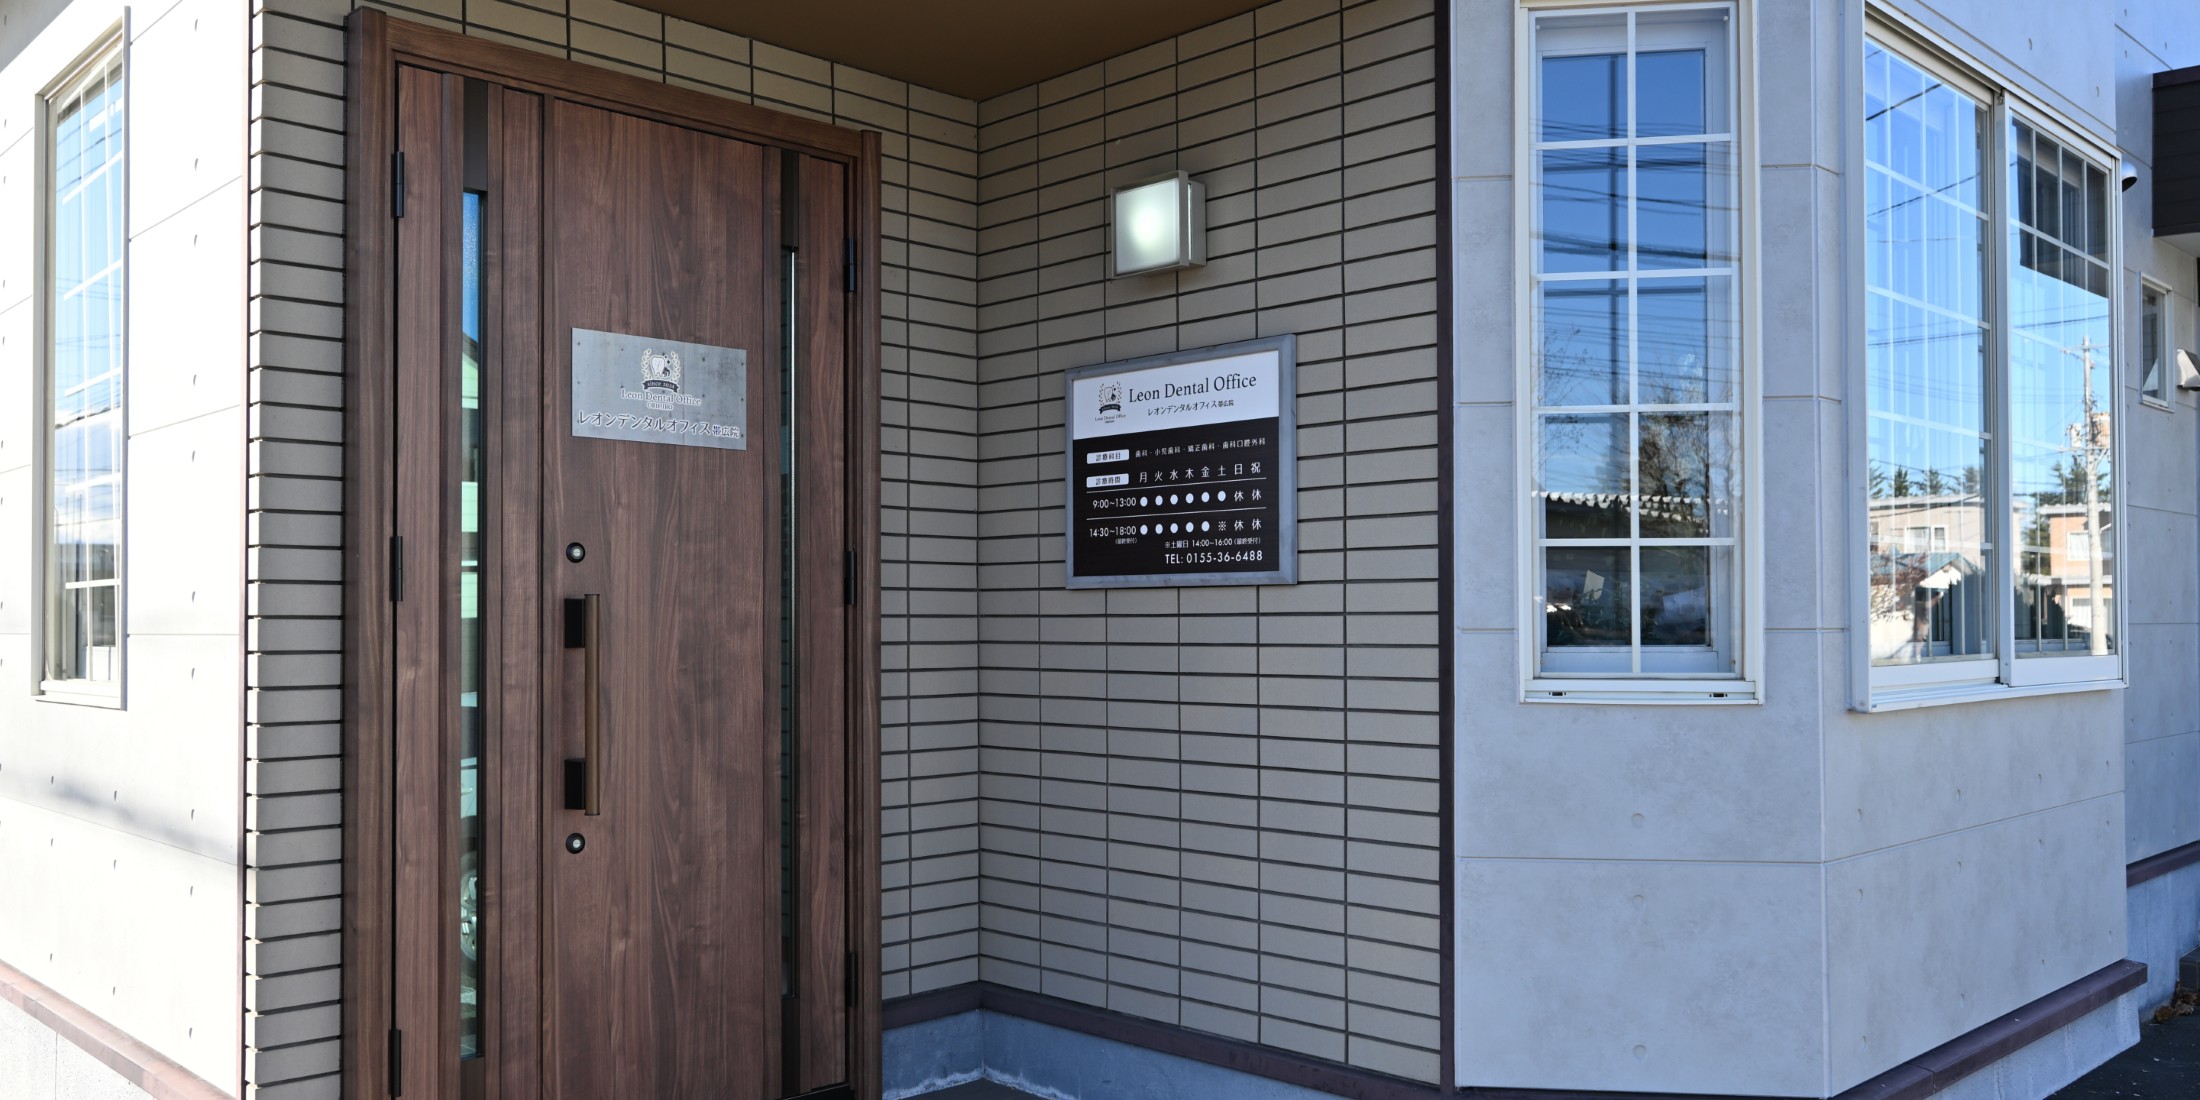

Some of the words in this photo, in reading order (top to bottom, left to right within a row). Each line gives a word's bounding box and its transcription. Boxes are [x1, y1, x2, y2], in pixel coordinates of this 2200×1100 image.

[1130, 388, 1160, 403] Leon
[1165, 378, 1209, 398] Dental
[1214, 373, 1256, 391] Office
[621, 390, 643, 400] Leon
[646, 392, 674, 403] Dental
[676, 396, 702, 406] Office
[1148, 399, 1234, 416] レオンデンタルオフィス帯広院
[578, 410, 740, 439] レオンデンタルオフィス帯広院
[1095, 453, 1122, 462] 診療科目
[1095, 476, 1121, 485] 診療時間
[1139, 472, 1147, 483] 月
[1154, 470, 1163, 482] 火
[1170, 469, 1179, 480] 水
[1185, 468, 1194, 479] 木
[1201, 466, 1210, 478] 金
[1217, 465, 1227, 476] 土
[1234, 464, 1243, 475] 日
[1251, 462, 1261, 474] 祝
[1092, 497, 1136, 509] 9:00~13:00
[1234, 490, 1244, 501] 休
[1252, 489, 1262, 500] 休
[1089, 526, 1136, 538] 14:30~18:00
[1234, 520, 1244, 531] 休
[1252, 518, 1262, 530] 休
[1165, 553, 1184, 564] TEL:
[1187, 550, 1263, 563] 0155-36-6488
